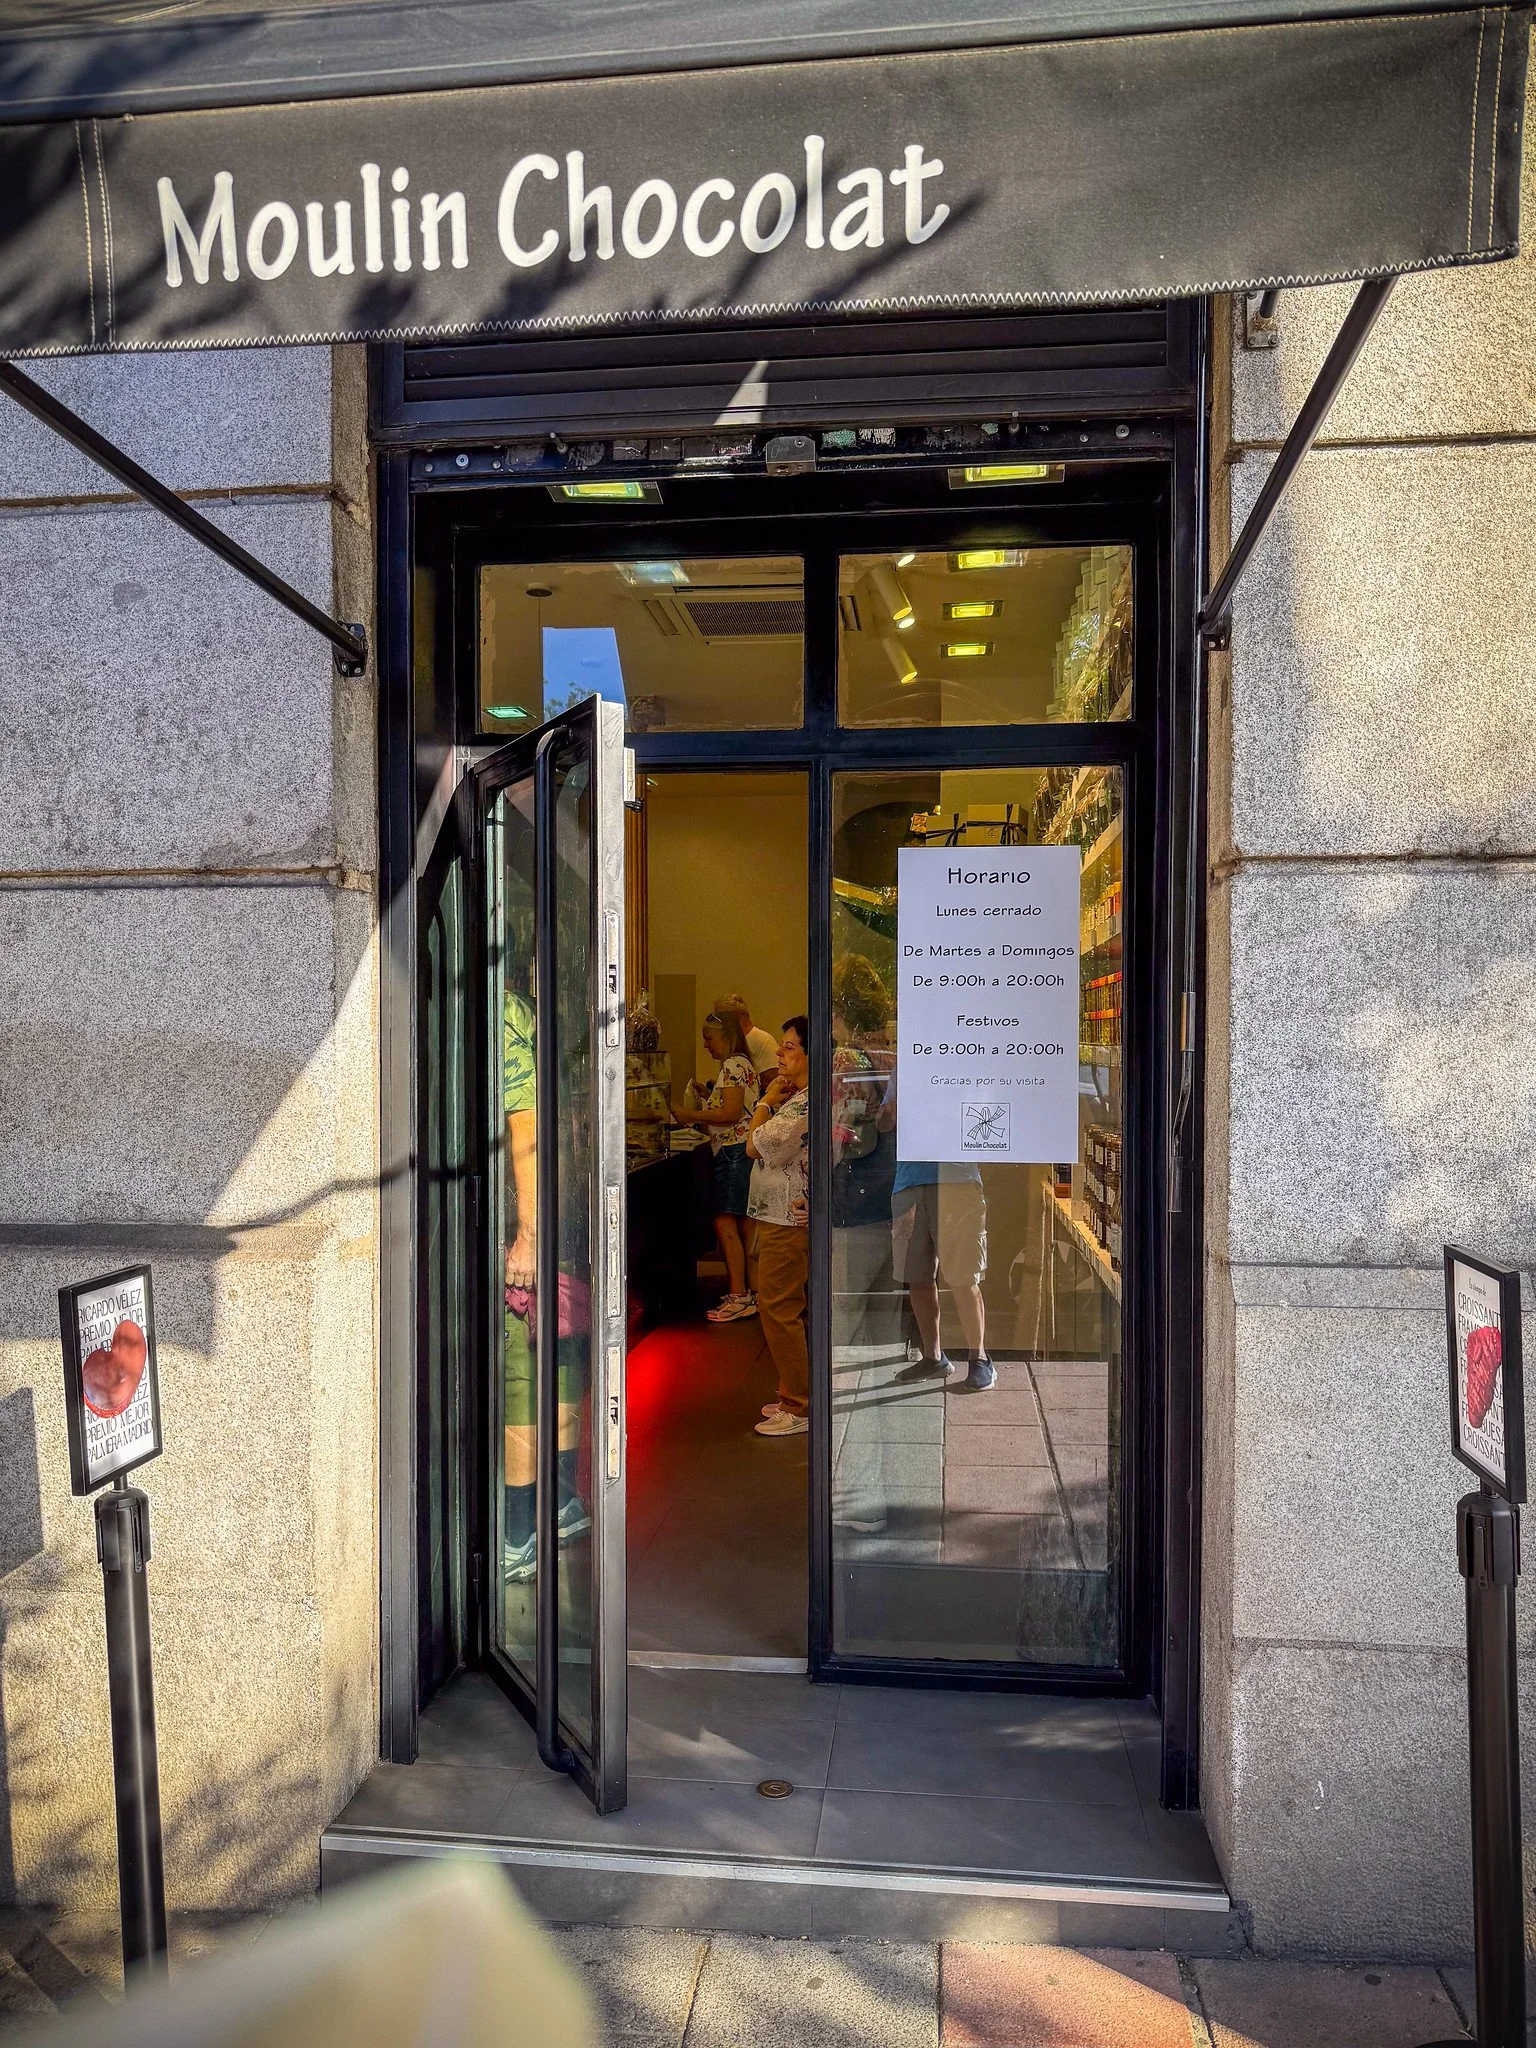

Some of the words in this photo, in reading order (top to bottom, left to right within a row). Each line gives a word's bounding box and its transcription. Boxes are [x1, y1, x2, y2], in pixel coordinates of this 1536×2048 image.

[157, 162, 469, 288] Moulin
[497, 134, 950, 268] Chocolat
[948, 867, 1031, 885] Horario
[936, 905, 977, 917] Lunes
[983, 904, 1042, 917] cerrado
[903, 945, 924, 957] De
[929, 945, 982, 957] Martes
[987, 948, 996, 957] a
[1002, 945, 1075, 959] Domingos
[913, 975, 933, 987] De
[939, 975, 986, 987] 9:00h
[992, 978, 1000, 987] a
[1006, 975, 1065, 987] 20:00h
[957, 1015, 1020, 1027] Festivos
[913, 1043, 933, 1055] De
[939, 1043, 986, 1055] 9:00h
[991, 1046, 999, 1055] a
[1006, 1043, 1064, 1055] 20:00h
[931, 1075, 972, 1086] Gracias
[976, 1078, 996, 1088] por
[1000, 1078, 1012, 1086] su
[1016, 1075, 1046, 1086] visita
[963, 1141, 983, 1149] Moulin
[78, 1297, 115, 1324] RICARDO
[115, 1288, 143, 1311] VÉLEZ
[1458, 1291, 1501, 1328] CROISSANT
[80, 1319, 112, 1344] PREMIO
[119, 1401, 150, 1429] MEJOR
